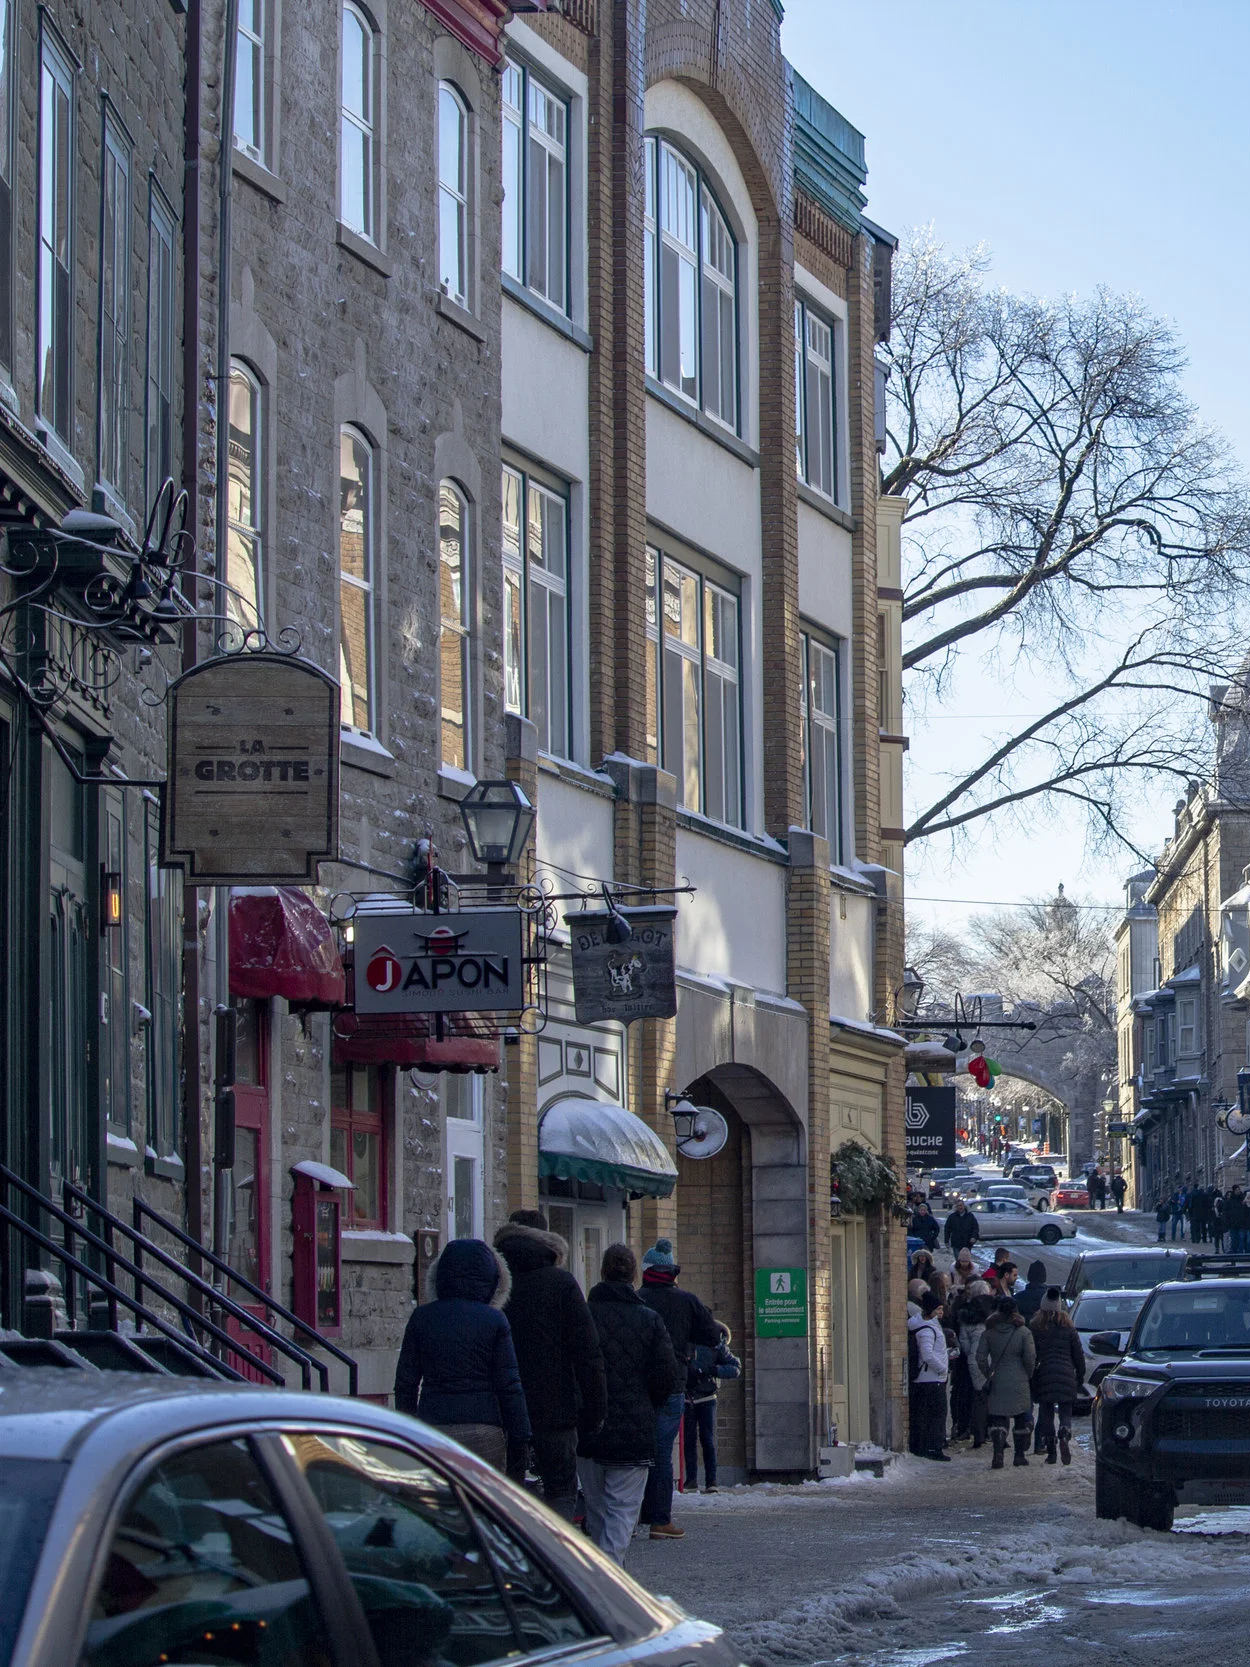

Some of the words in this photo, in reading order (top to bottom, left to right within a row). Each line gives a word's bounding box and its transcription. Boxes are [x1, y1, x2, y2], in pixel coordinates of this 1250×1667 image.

[239, 739, 266, 755] LA
[194, 760, 310, 781] GROTTE
[368, 955, 509, 992] JAPON
